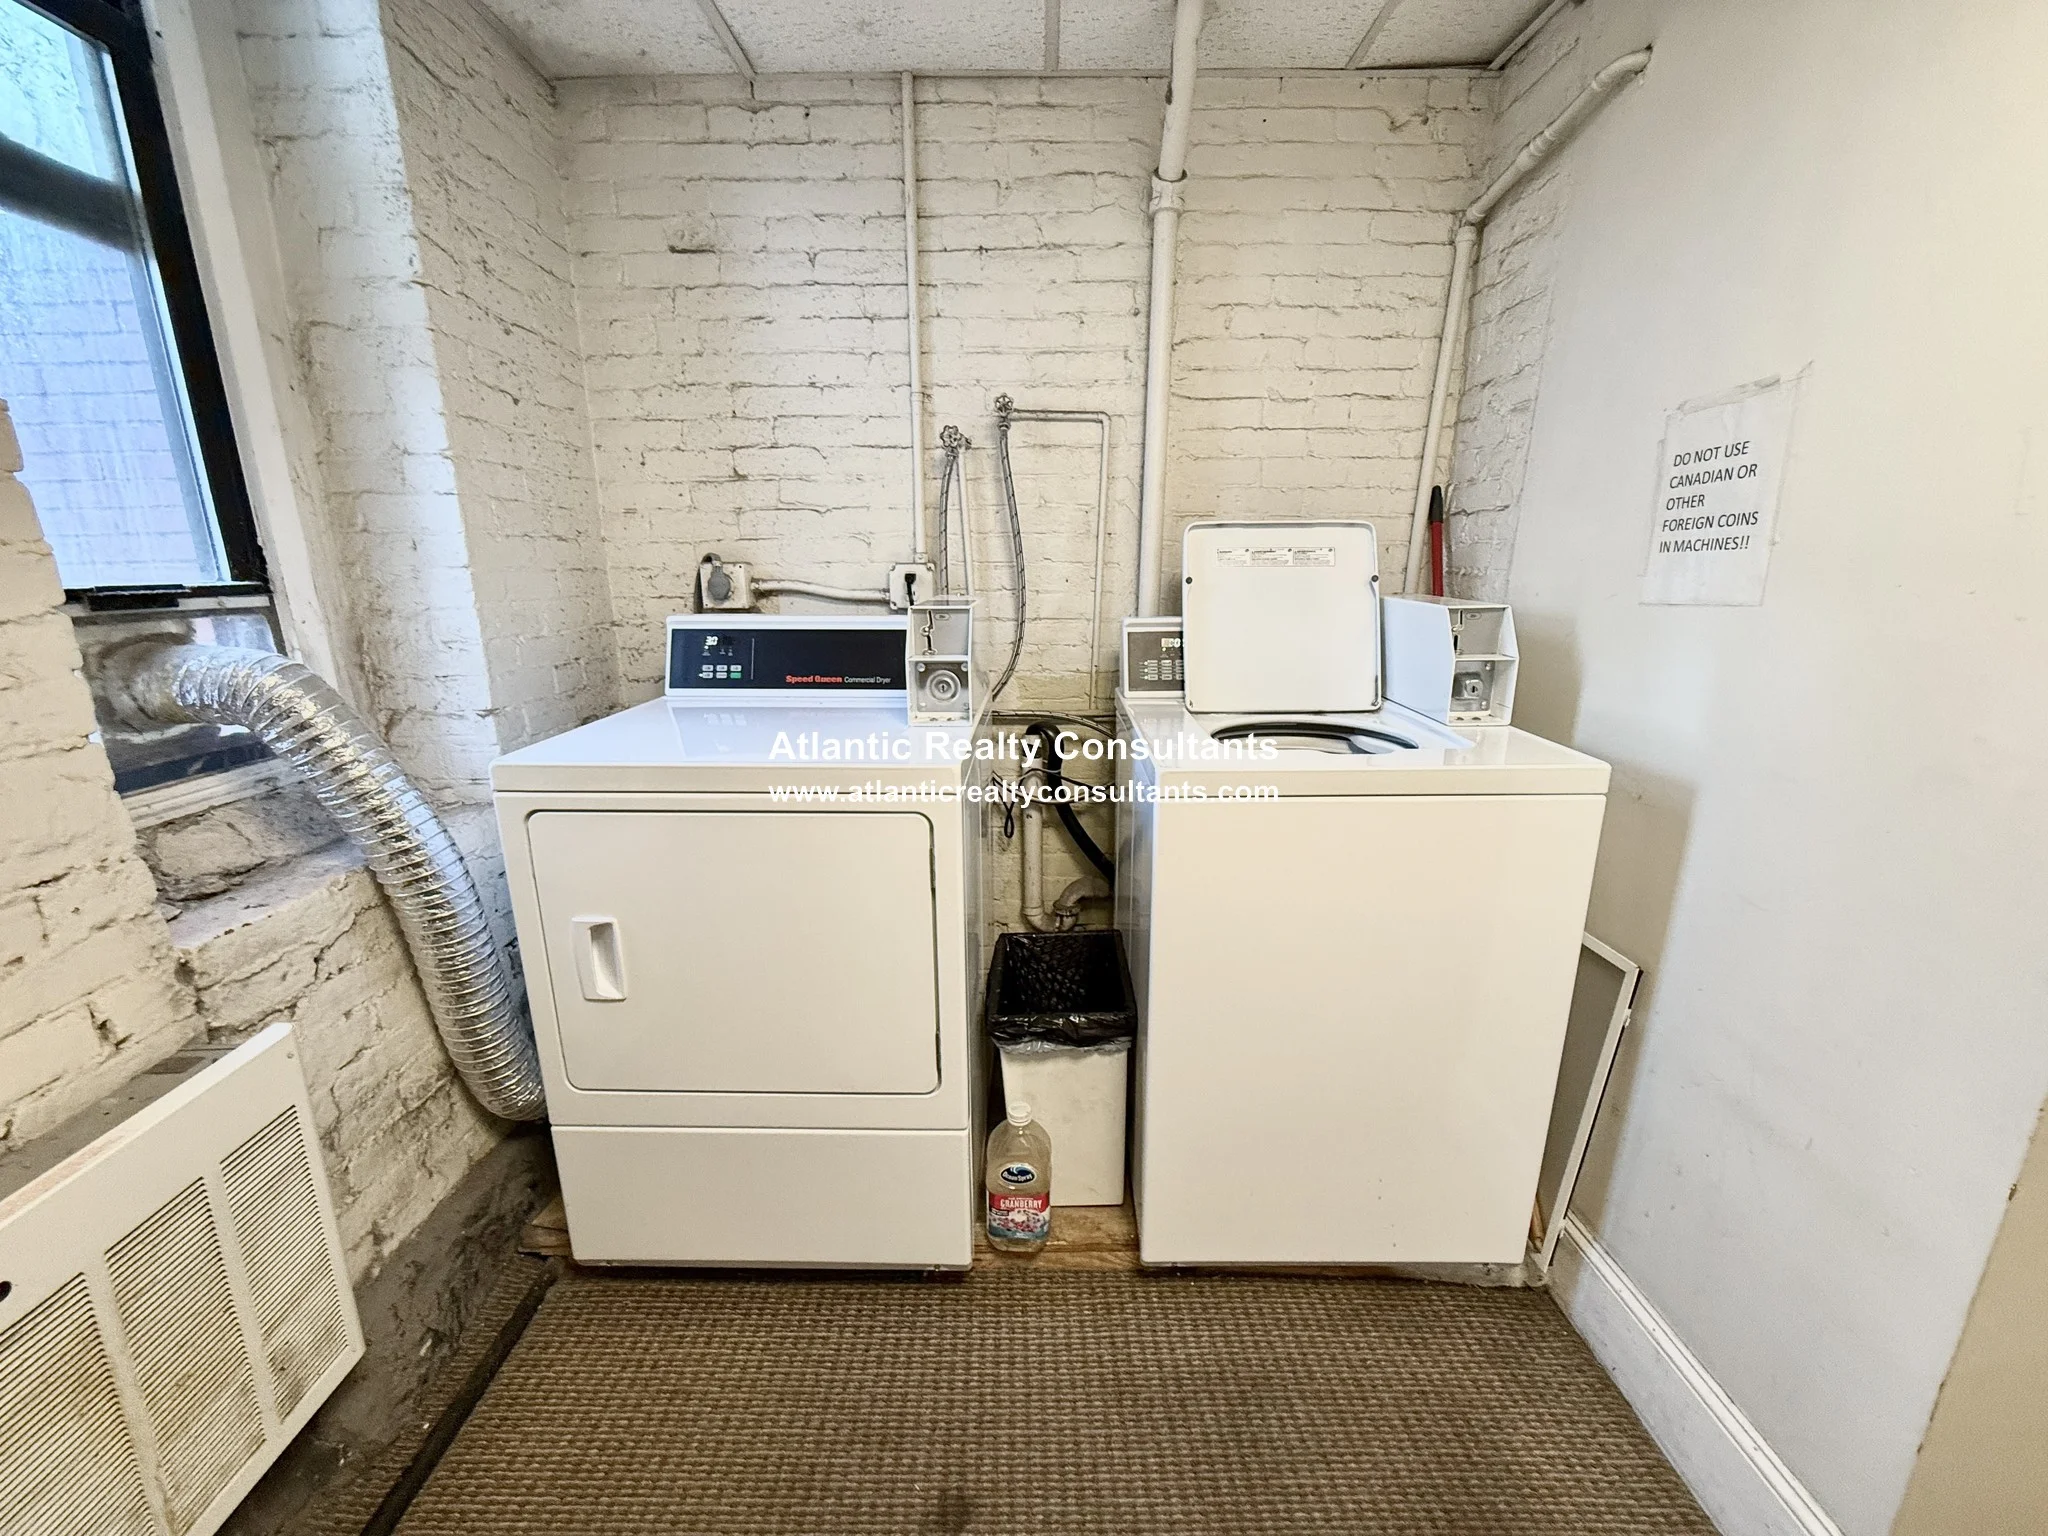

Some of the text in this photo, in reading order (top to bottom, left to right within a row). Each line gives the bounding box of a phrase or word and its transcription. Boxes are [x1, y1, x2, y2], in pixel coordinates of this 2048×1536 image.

[1673, 441, 1750, 467] DO NOT USE
[1669, 463, 1758, 488] CANADIAN OR
[1666, 494, 1705, 511] OTHER
[1662, 511, 1759, 532] FOREIGN COINS
[1659, 535, 1750, 553] IN MACHINES!!
[785, 675, 813, 684] Speed
[814, 675, 842, 683] Queen
[876, 676, 891, 684] Dryer
[1000, 1199, 1042, 1208] CRANBERRY
